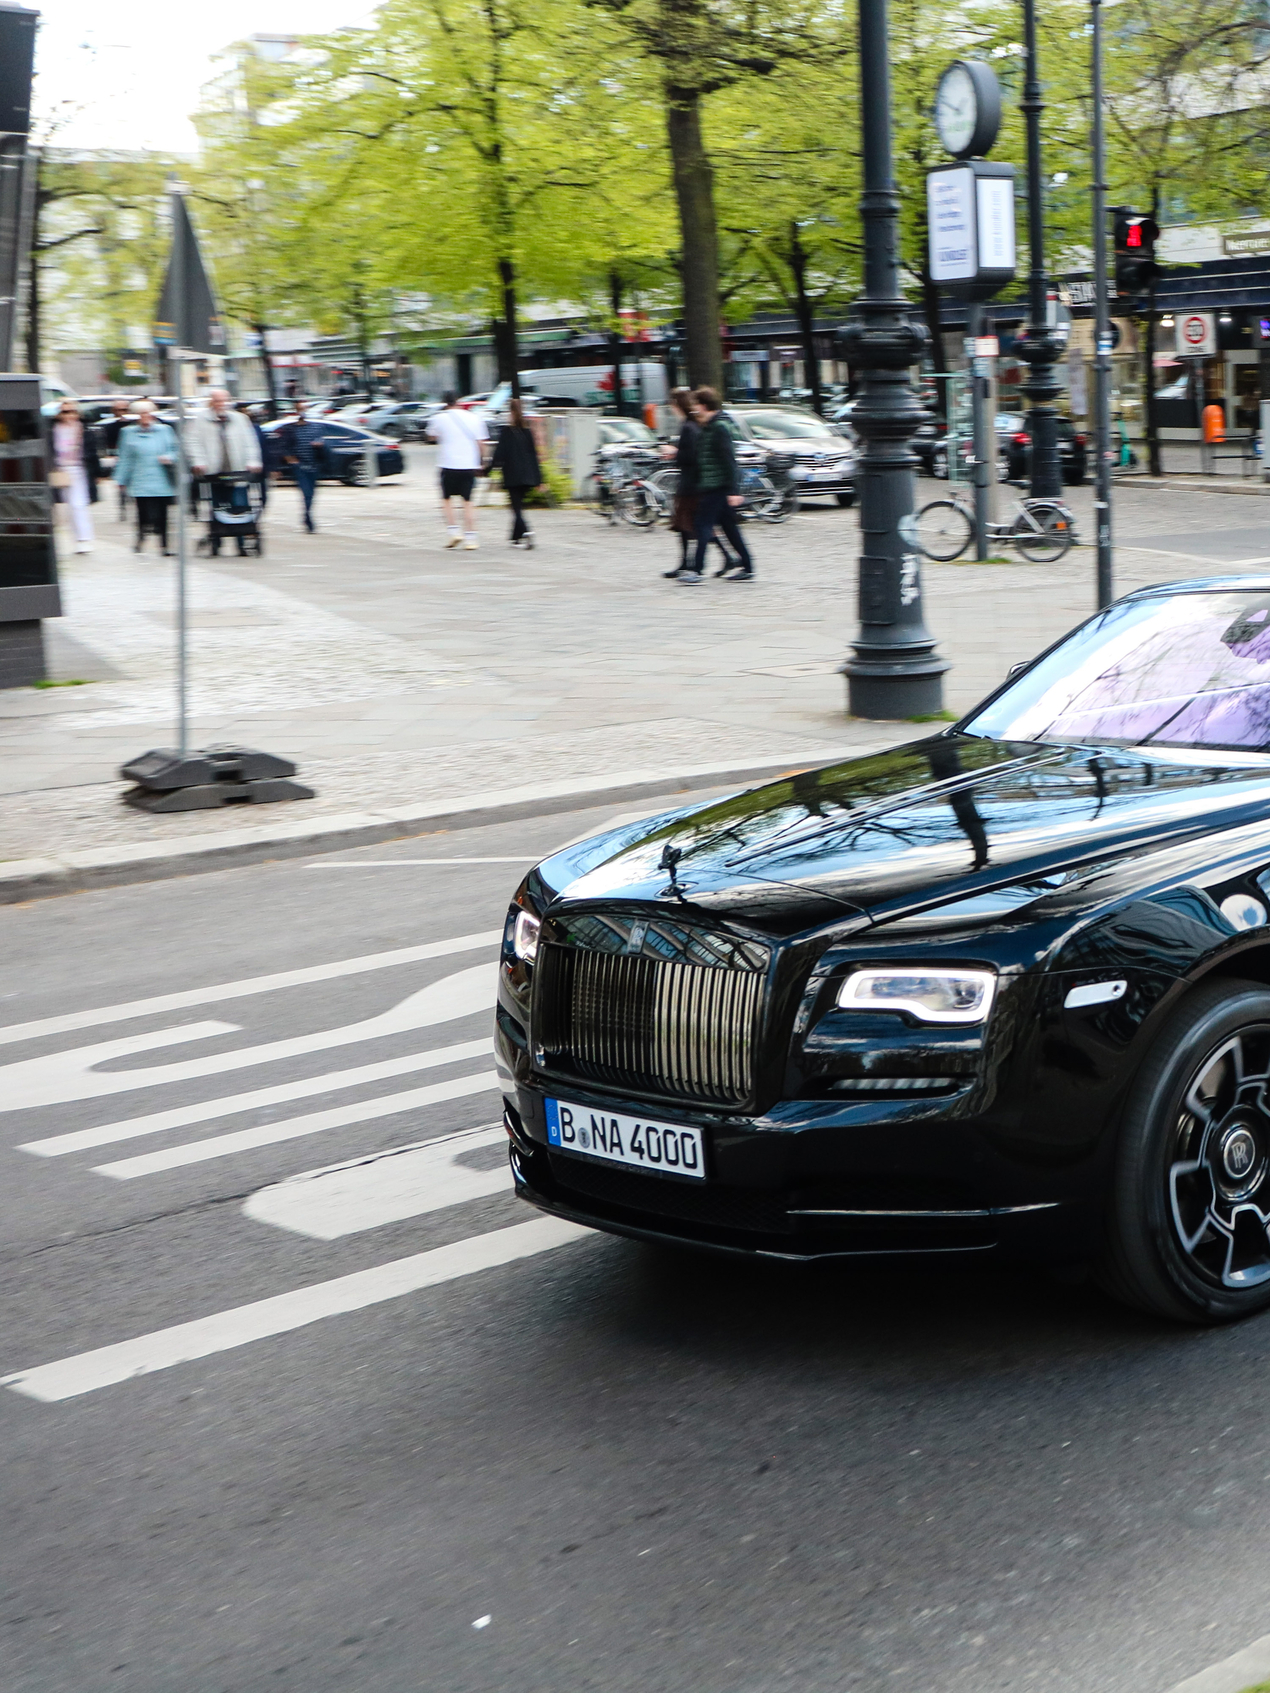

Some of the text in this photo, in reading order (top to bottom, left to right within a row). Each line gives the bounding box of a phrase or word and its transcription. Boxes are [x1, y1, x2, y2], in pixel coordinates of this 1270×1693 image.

[560, 1107, 698, 1170] B NA 4000
